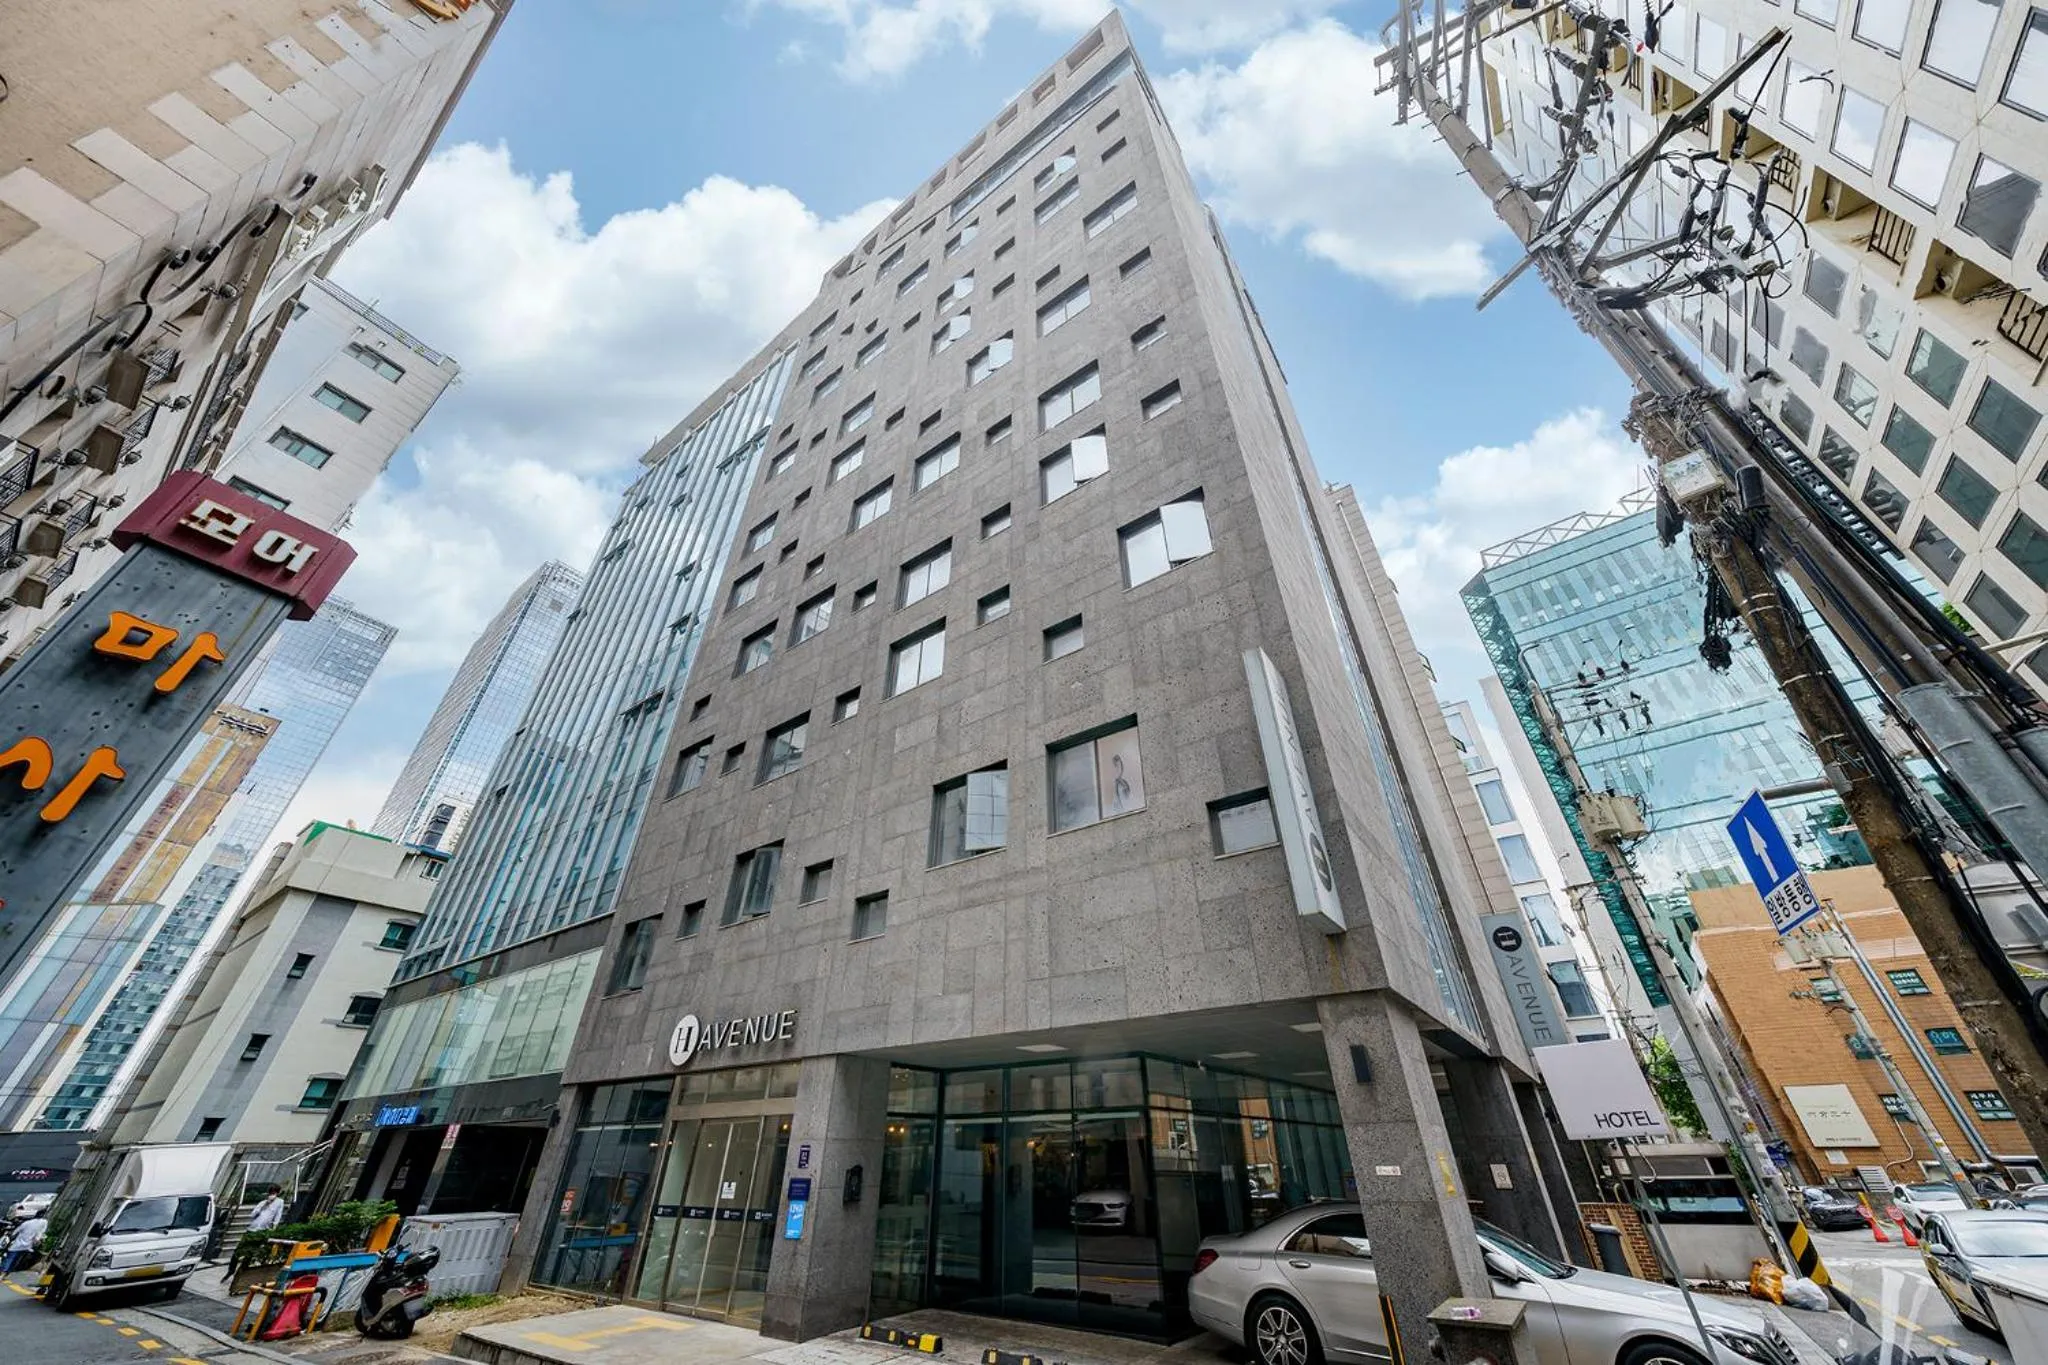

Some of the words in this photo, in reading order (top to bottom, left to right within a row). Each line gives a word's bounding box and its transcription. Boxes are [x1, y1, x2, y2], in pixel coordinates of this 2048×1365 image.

[1766, 874, 1813, 925] 일방통행
[1506, 954, 1552, 1041] AVENUE
[697, 1009, 796, 1052] AVENUE
[1594, 1110, 1660, 1129] HOTEL
